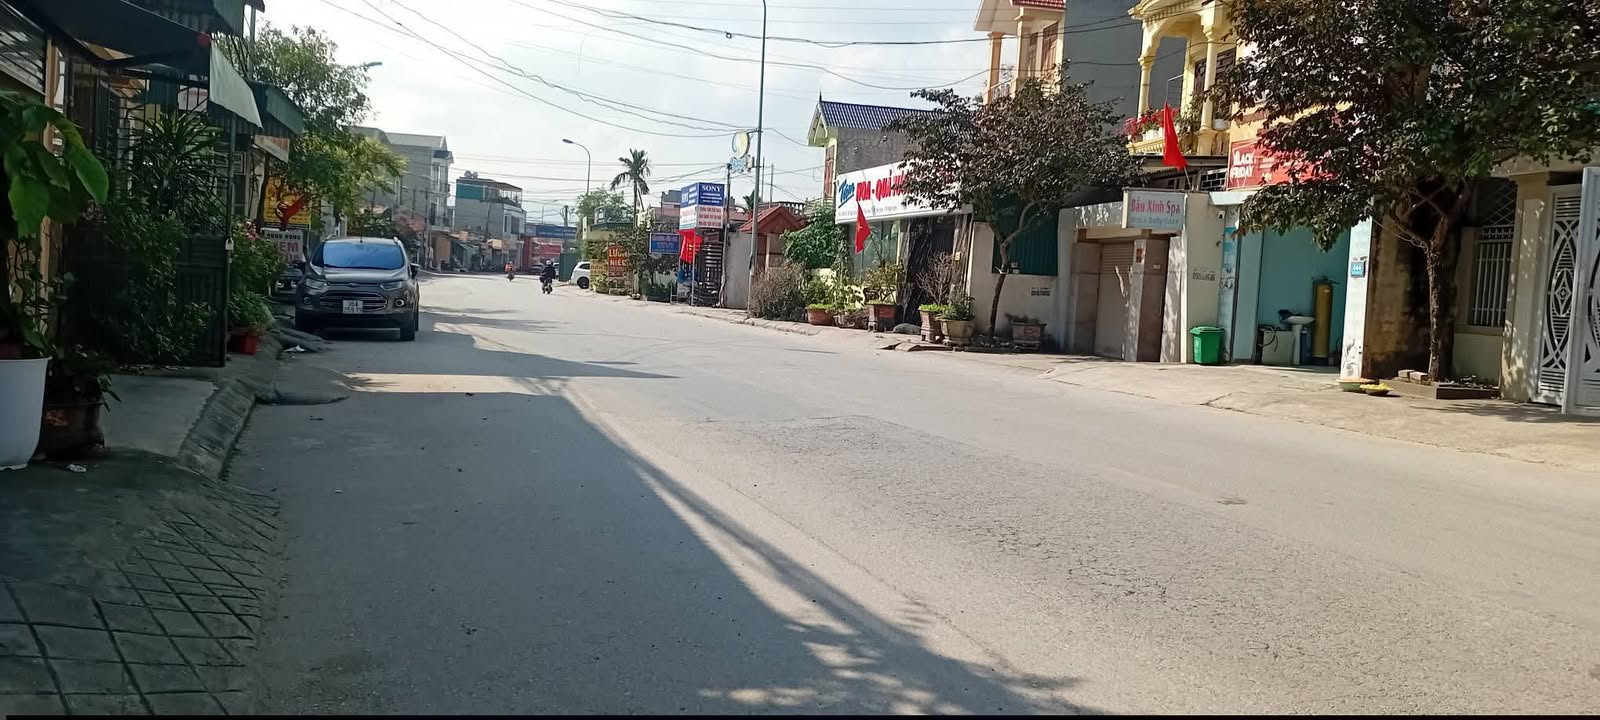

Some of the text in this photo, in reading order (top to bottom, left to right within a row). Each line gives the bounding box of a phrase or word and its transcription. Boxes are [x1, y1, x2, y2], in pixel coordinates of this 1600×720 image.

[1233, 151, 1254, 165] BLACK
[1230, 166, 1253, 178] FRIDAY
[1166, 200, 1181, 216] Spa
